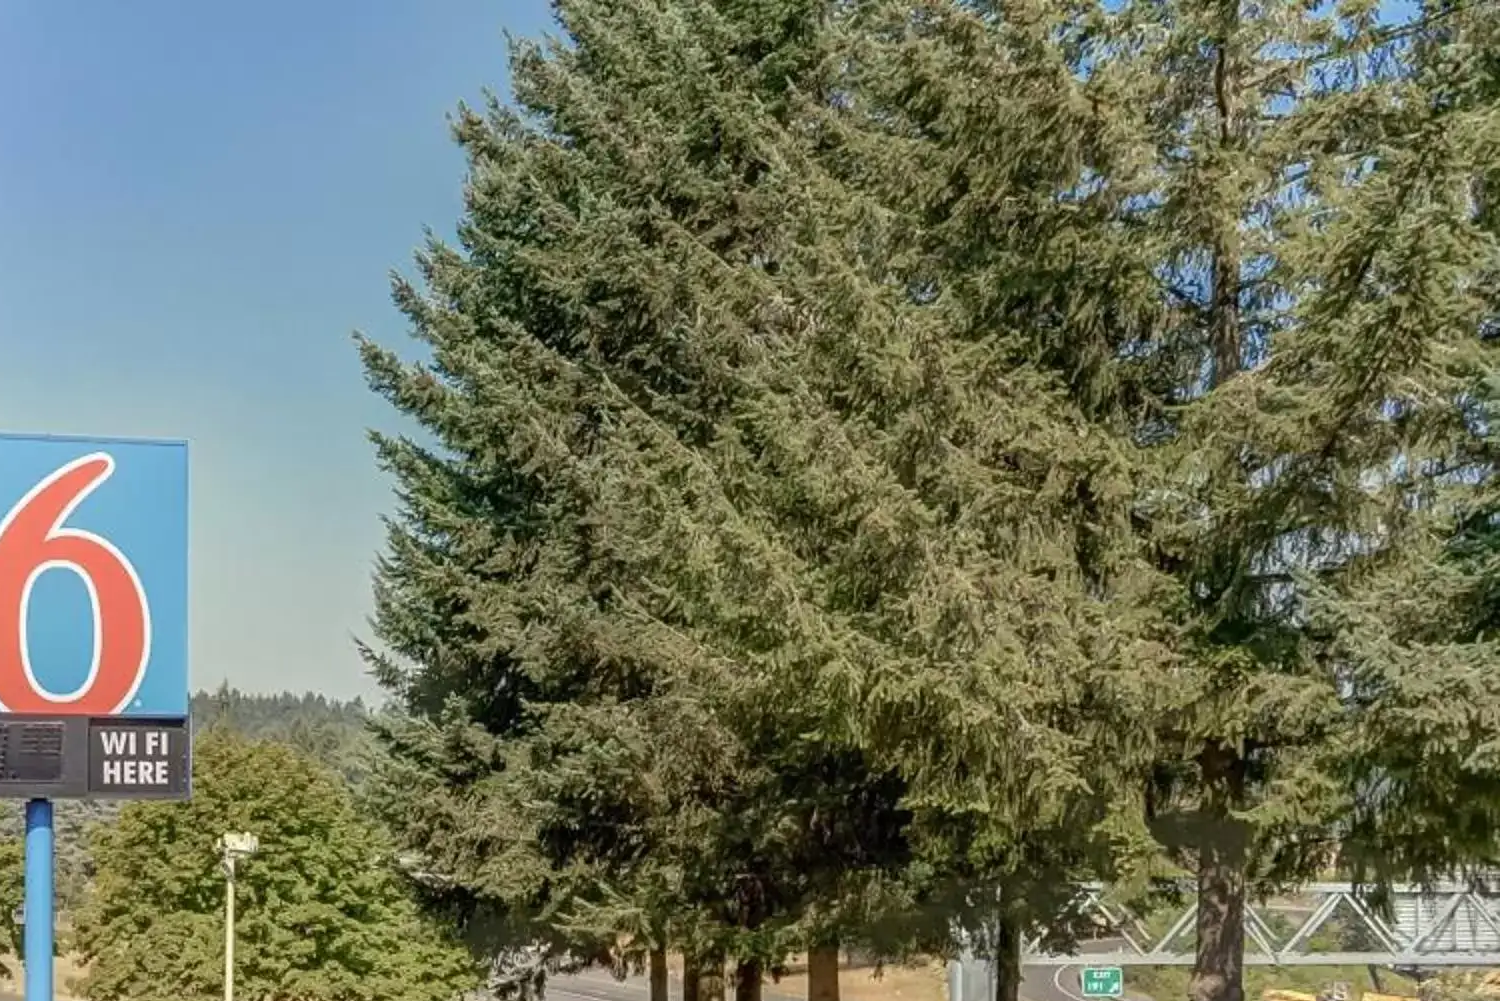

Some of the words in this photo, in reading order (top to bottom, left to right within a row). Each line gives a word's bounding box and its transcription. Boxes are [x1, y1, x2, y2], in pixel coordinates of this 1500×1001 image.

[100, 731, 137, 756] WI
[145, 731, 169, 756] FI
[103, 760, 169, 785] HERE
